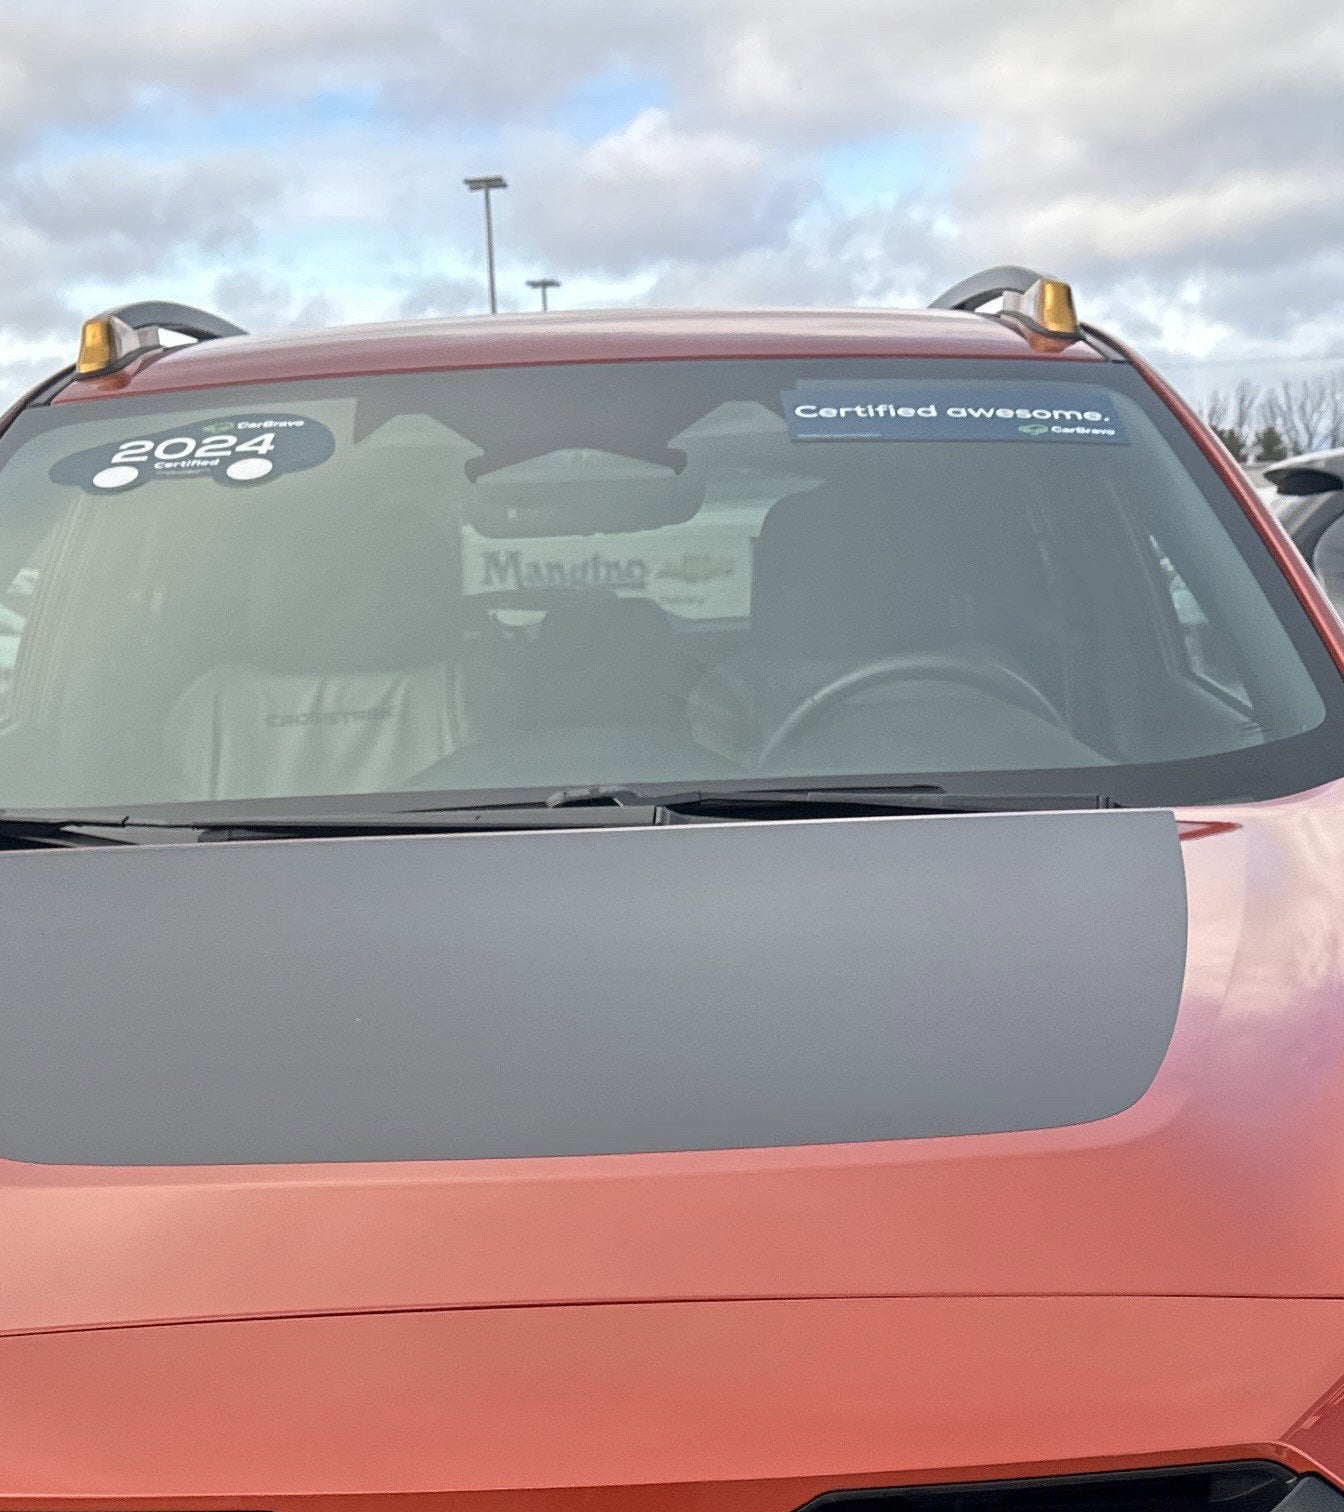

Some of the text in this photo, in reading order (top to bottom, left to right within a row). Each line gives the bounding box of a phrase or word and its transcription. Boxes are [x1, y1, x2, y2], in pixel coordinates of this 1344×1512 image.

[794, 403, 1111, 422] Certified awesome.
[110, 432, 276, 464] 2024
[153, 457, 221, 470] Certified
